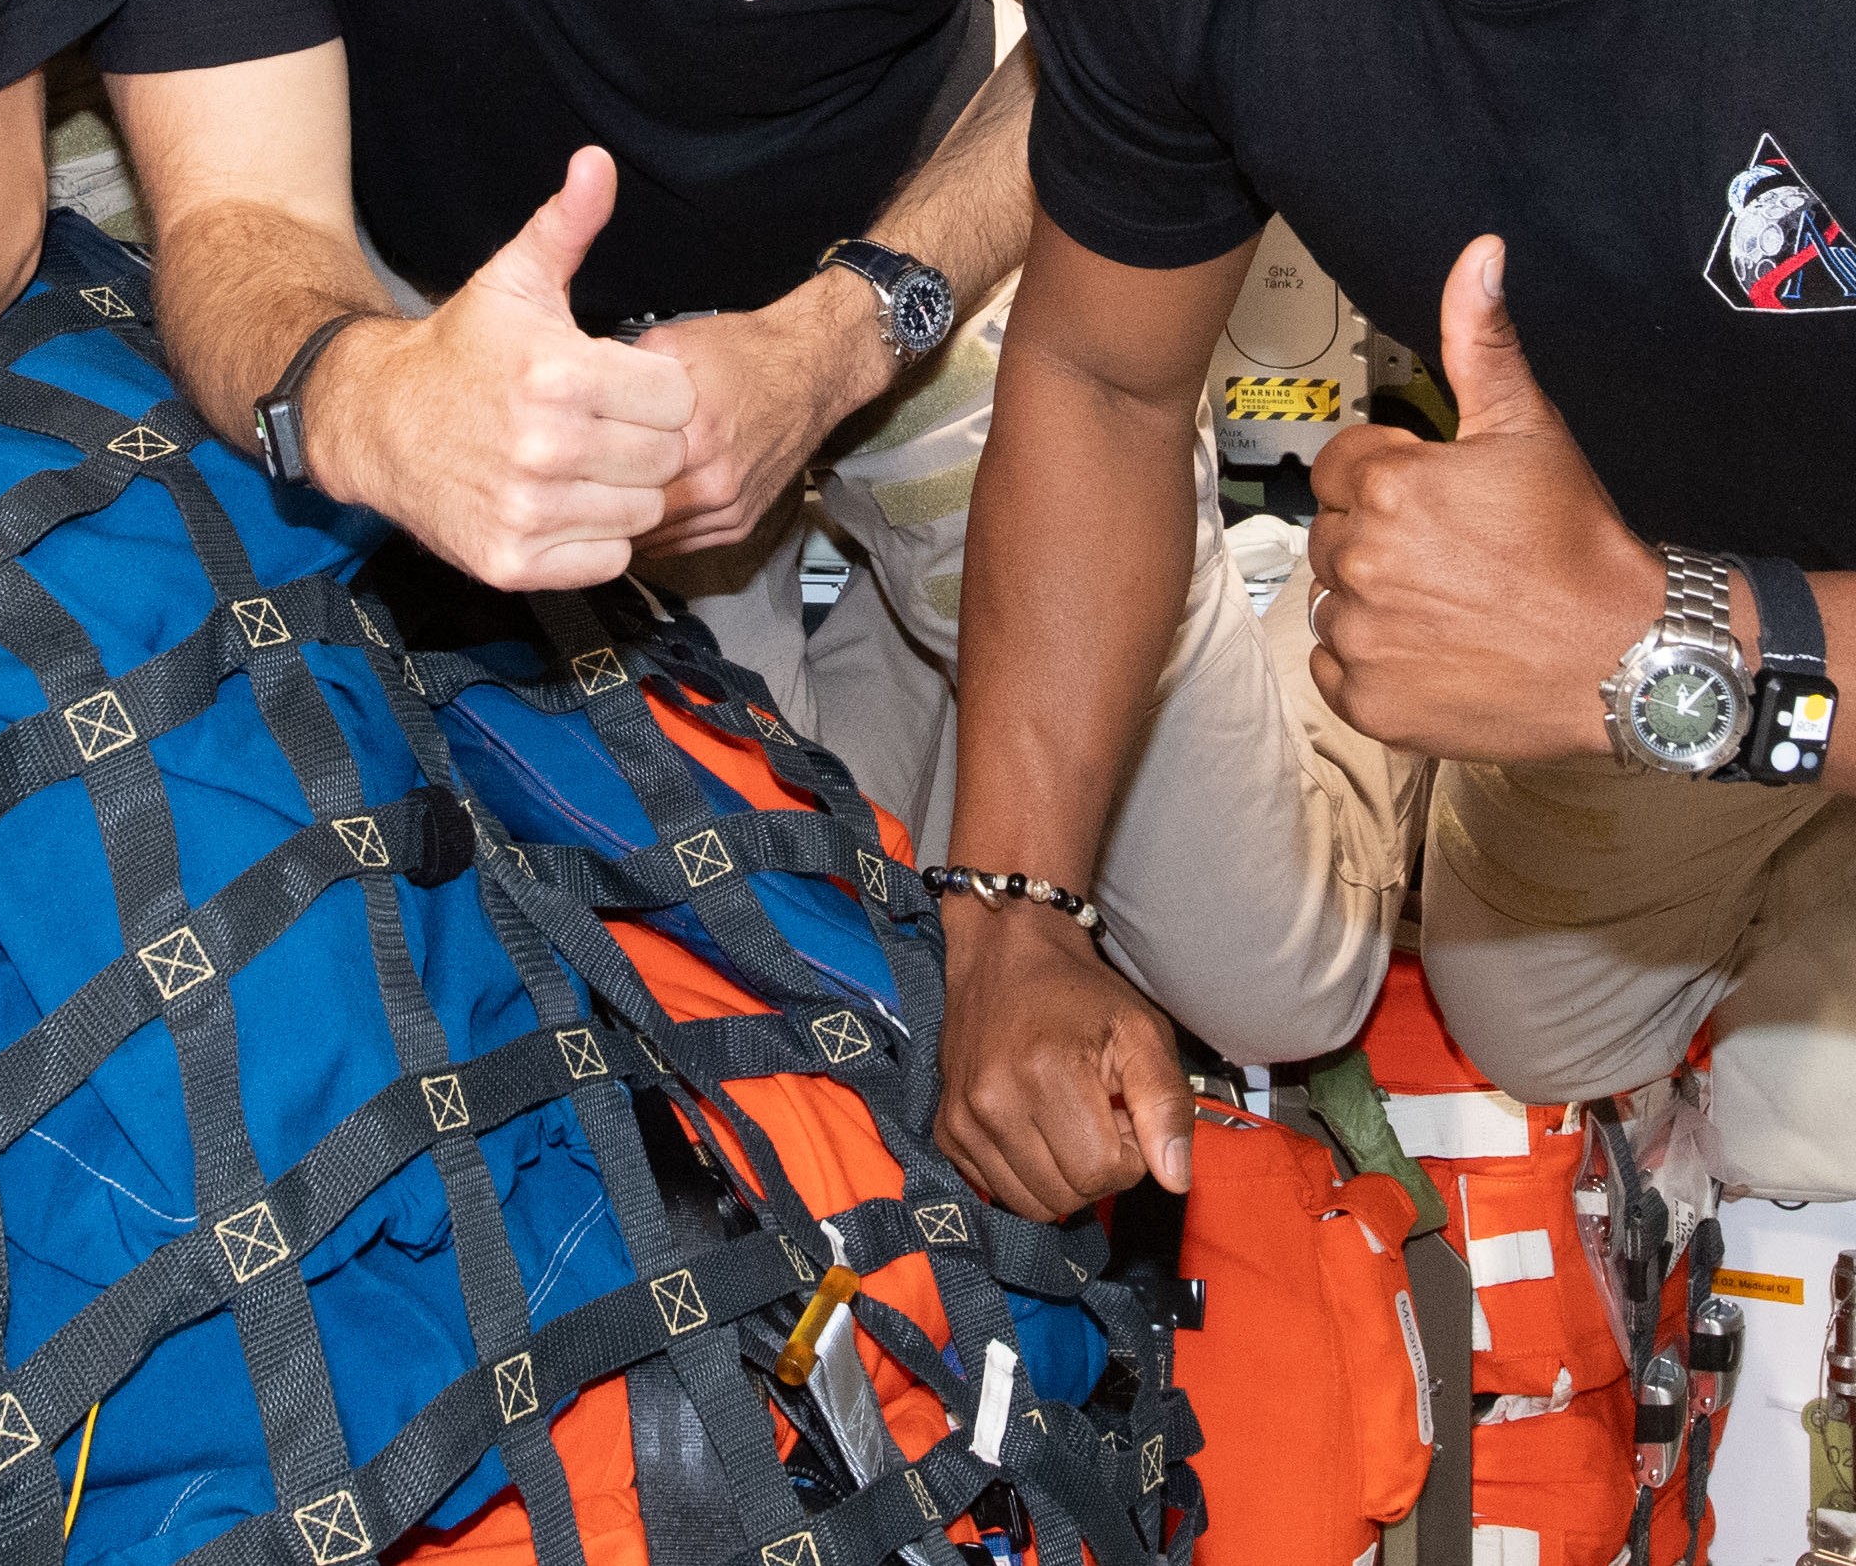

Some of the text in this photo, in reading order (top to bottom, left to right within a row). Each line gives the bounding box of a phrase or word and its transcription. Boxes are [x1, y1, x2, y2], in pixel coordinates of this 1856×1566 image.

[1268, 266, 1297, 277] GN2
[1263, 279, 1304, 289] Tank 2
[1241, 389, 1291, 397] WARNING
[1220, 428, 1243, 437] Aux
[1738, 1279, 1775, 1293] Medical
[1401, 1299, 1426, 1382] Mooring
